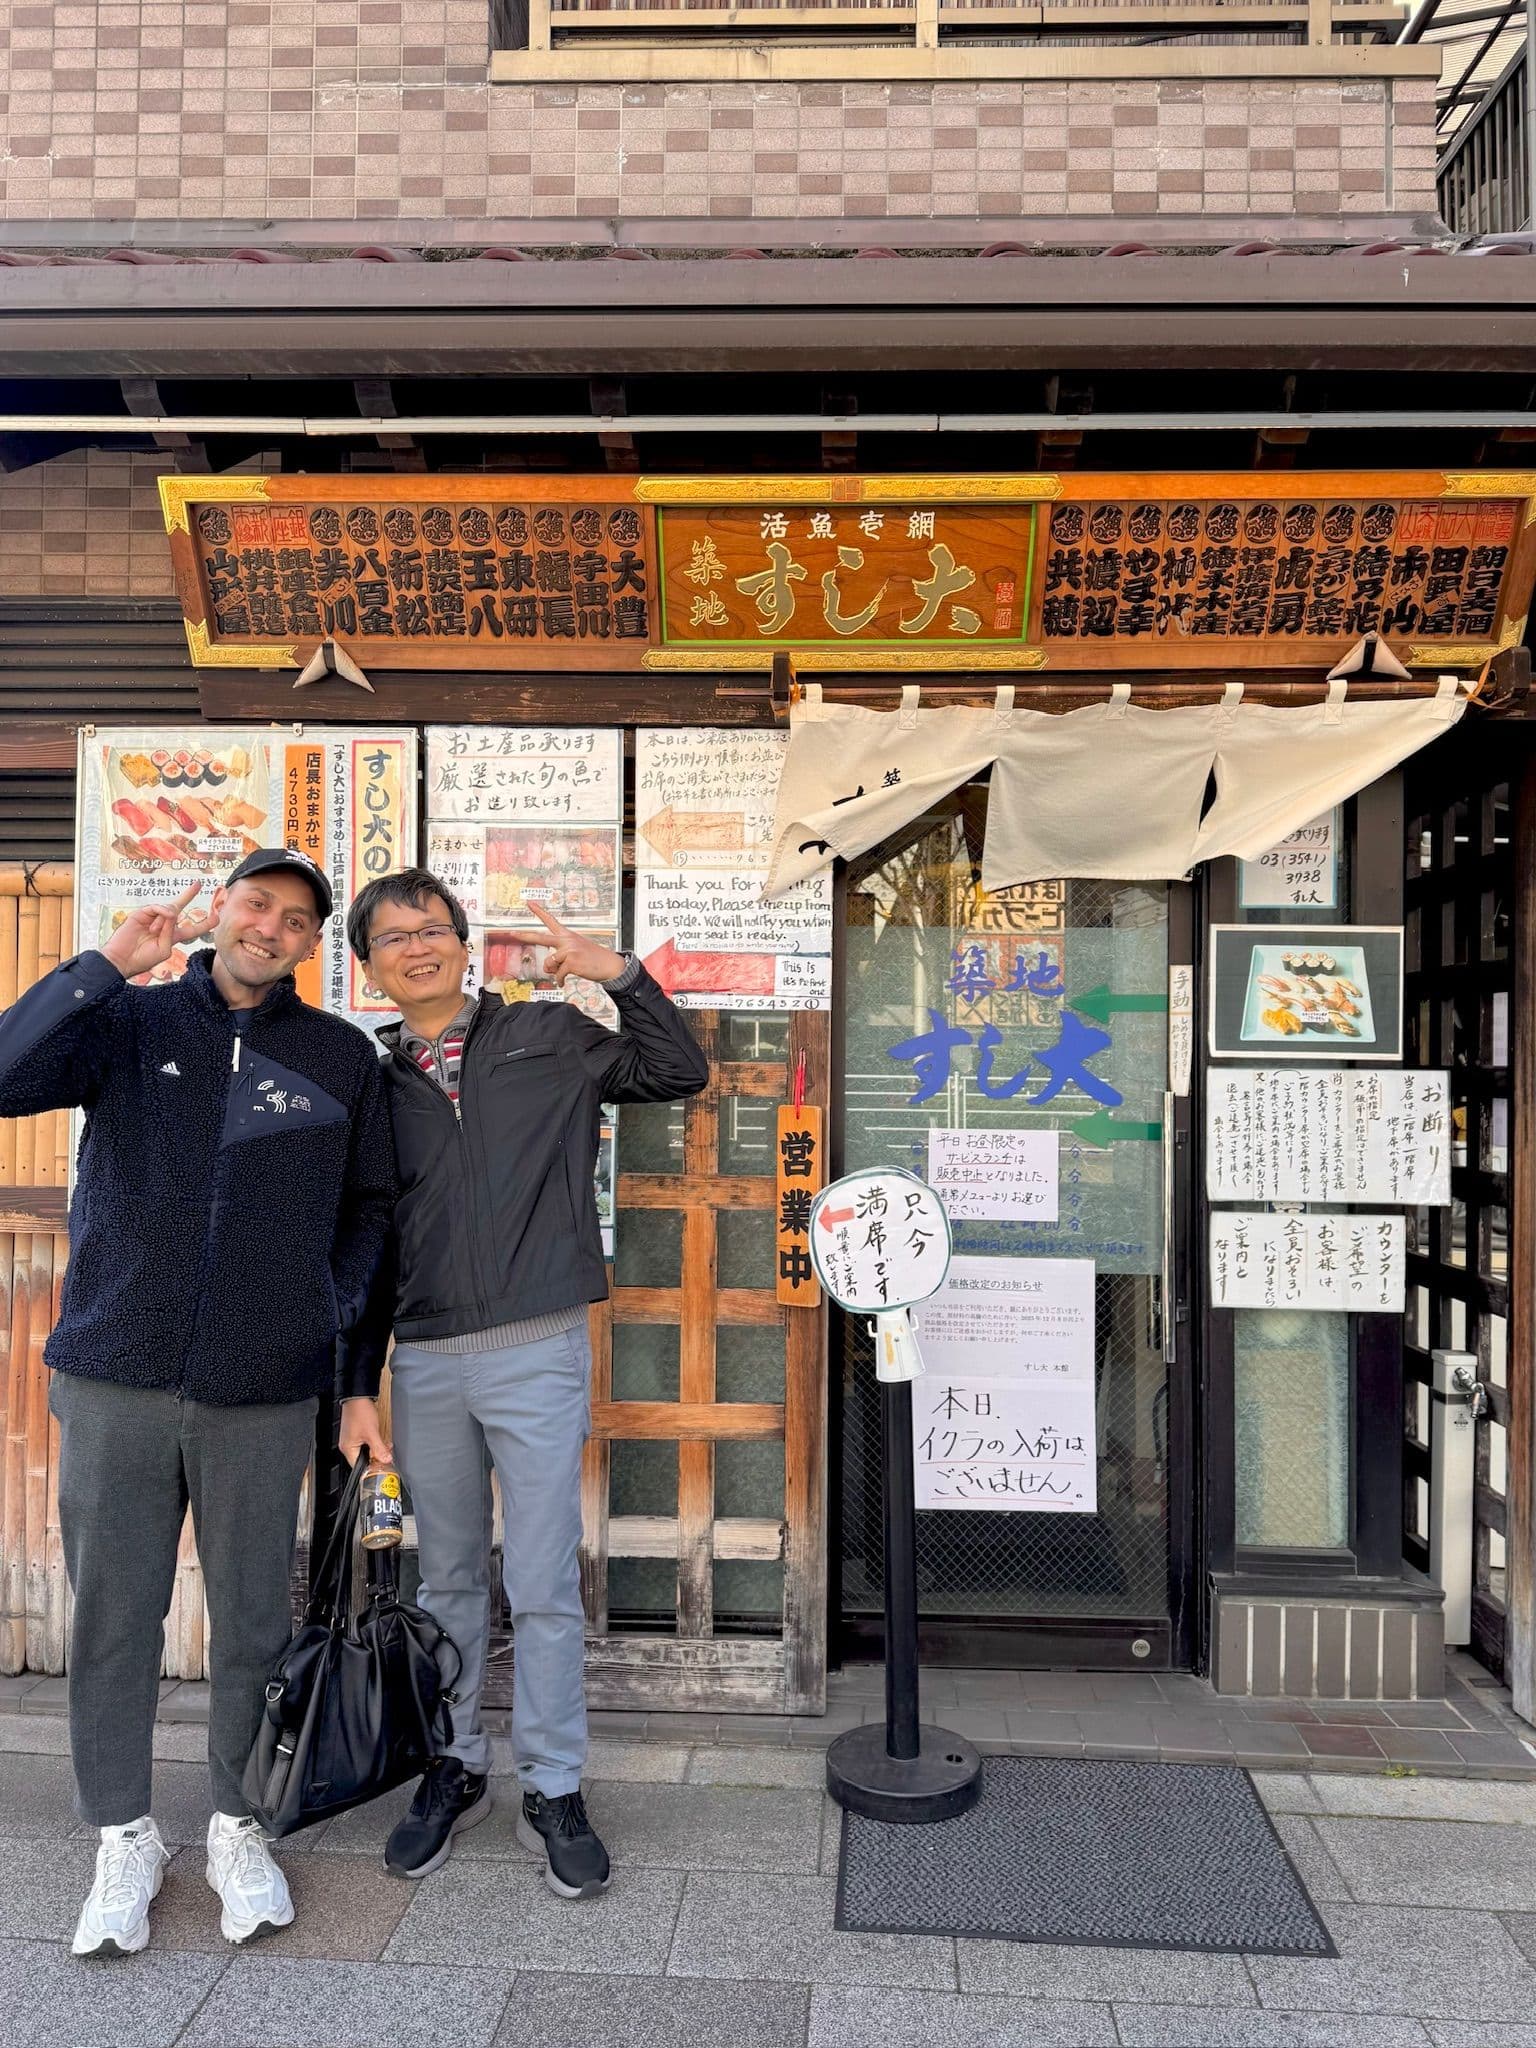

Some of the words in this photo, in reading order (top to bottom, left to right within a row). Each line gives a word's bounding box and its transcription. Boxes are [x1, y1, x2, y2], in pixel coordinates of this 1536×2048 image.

[351, 547, 396, 637] 八百金
[461, 548, 504, 638] 玉八
[573, 549, 612, 639] 宇田川
[684, 535, 729, 628] 築地
[735, 541, 983, 636] すし大
[447, 731, 597, 756] お土産品承ります
[432, 760, 609, 793] 厳選された旬の魚で
[305, 751, 323, 849] 店長おまかせ
[429, 837, 484, 852] おまかせ
[1260, 852, 1327, 869] 03(3541)
[644, 874, 688, 891] Thank
[696, 880, 725, 896] you
[1286, 869, 1321, 885] 3738
[1290, 889, 1325, 904] すし大
[648, 900, 667, 910] us
[712, 897, 754, 911] Please
[722, 914, 743, 928] will
[778, 918, 801, 931] you
[676, 930, 703, 942] your
[704, 930, 730, 941] seat
[731, 930, 744, 941] is
[746, 930, 787, 943] ready.
[782, 960, 802, 974] This
[806, 960, 816, 974] is
[945, 946, 1066, 1003] 築地
[1173, 969, 1189, 1008] 手動
[735, 998, 743, 1008] 7
[746, 998, 754, 1008] 6
[767, 998, 775, 1010] 4
[792, 998, 801, 1008] 2
[887, 1008, 1124, 1107] すし大
[1367, 1072, 1382, 1121] お席の指定
[1421, 1082, 1444, 1175] お断り
[945, 1151, 1027, 1166] サービスランチは
[779, 1130, 816, 1290] 営業中
[903, 1191, 935, 1259] 只今
[836, 1226, 858, 1298] 順番にご案内
[1234, 1217, 1254, 1279] ご案内と
[1284, 1217, 1304, 1301] 全員おそろい
[1344, 1226, 1369, 1292] ご希望の
[1377, 1220, 1395, 1305] カウンターを
[948, 1278, 1043, 1291] 価格改定のお知らせ
[1214, 1238, 1230, 1303] なります
[1023, 1362, 1048, 1372] すし大
[1053, 1363, 1070, 1372] 本館
[934, 1465, 1084, 1499] ございません。
[121, 1829, 139, 1840] NIKE
